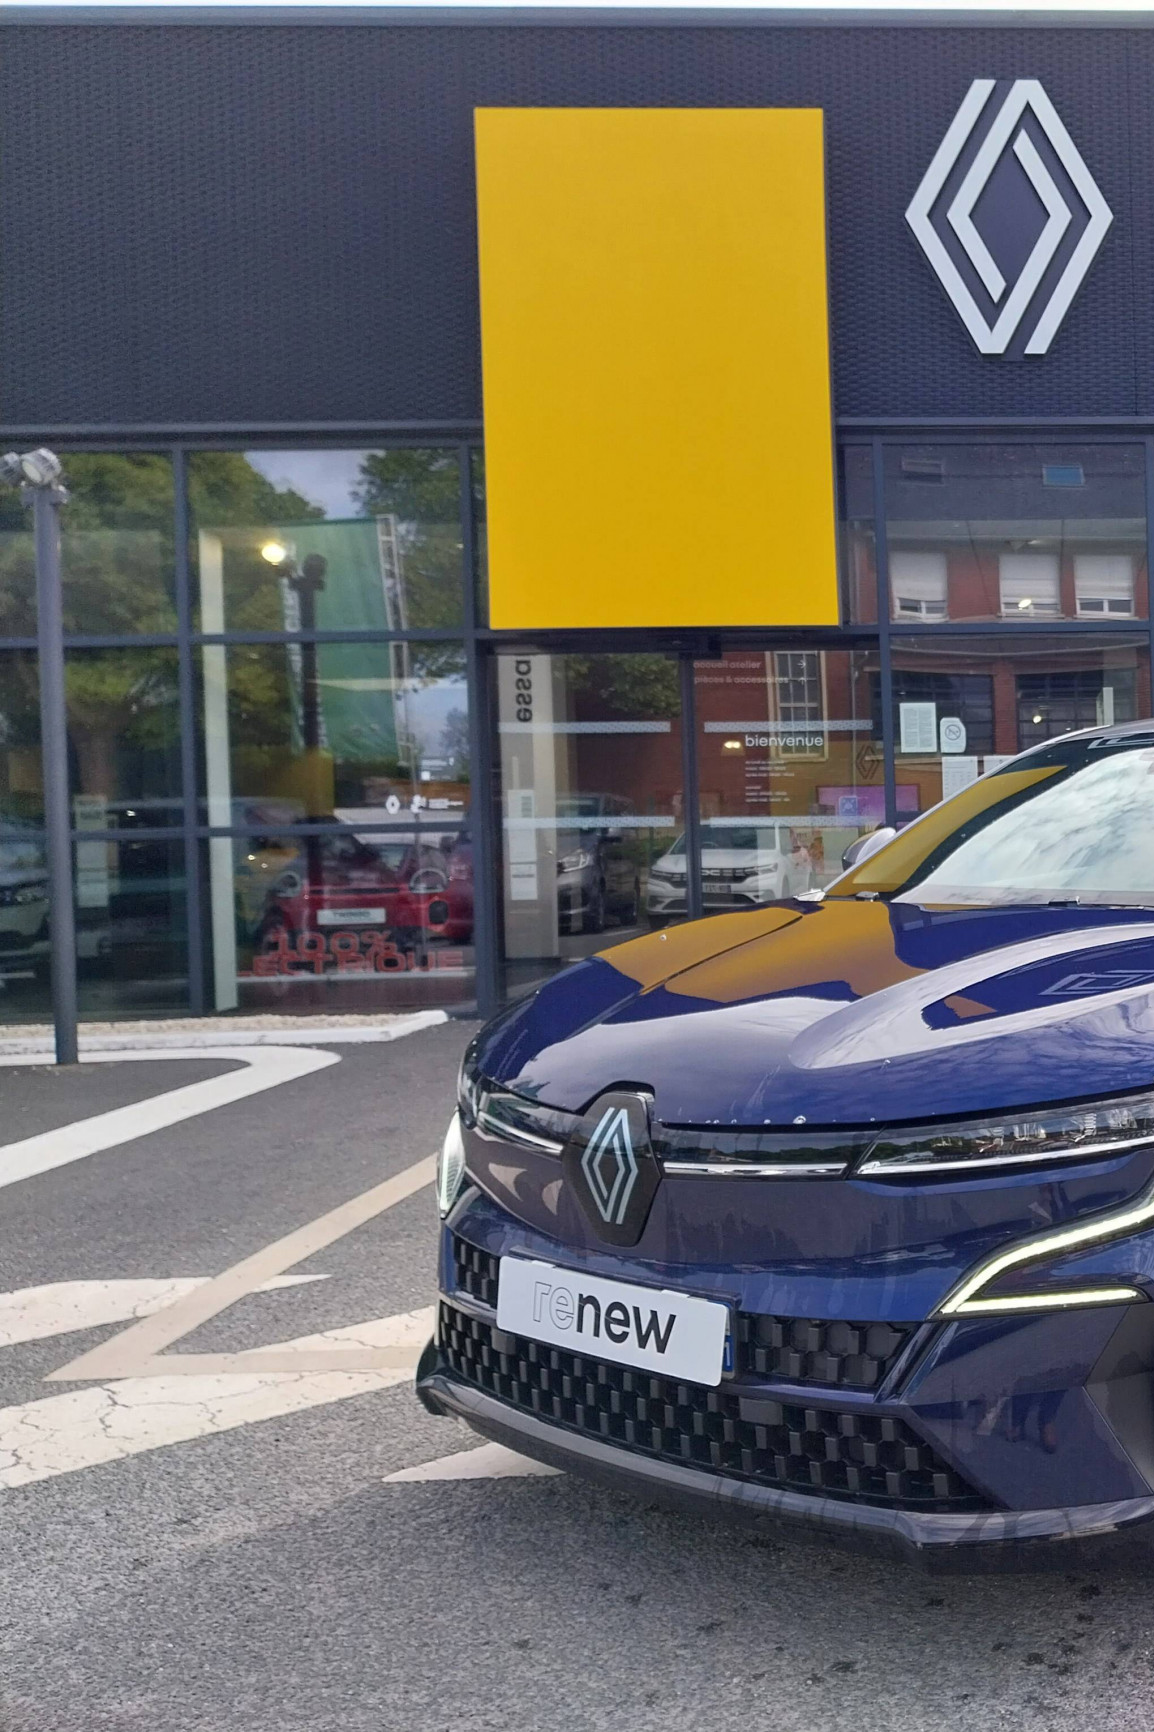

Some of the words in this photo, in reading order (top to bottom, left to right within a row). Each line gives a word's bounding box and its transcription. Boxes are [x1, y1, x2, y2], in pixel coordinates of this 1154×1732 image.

[729, 660, 761, 669] atelier
[745, 734, 824, 747] bienvenue
[270, 928, 398, 956] 100%
[532, 1281, 677, 1355] renew
